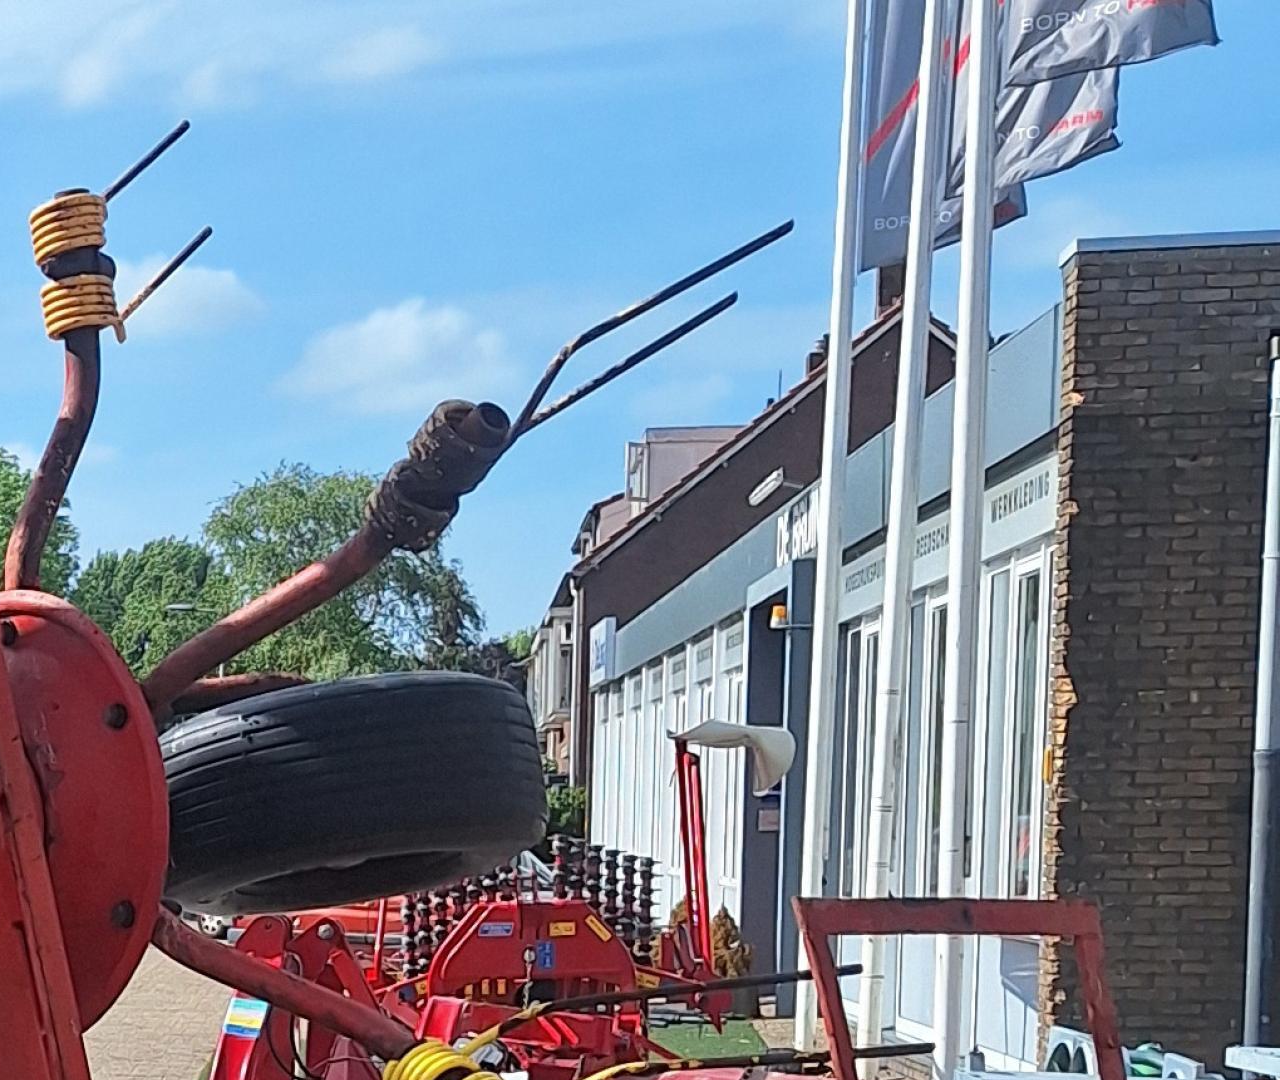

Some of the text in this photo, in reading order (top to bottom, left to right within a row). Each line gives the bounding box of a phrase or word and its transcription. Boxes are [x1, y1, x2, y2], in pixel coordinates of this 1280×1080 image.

[1020, 11, 1086, 34] BORN
[1094, 1, 1120, 17] TO
[991, 470, 1050, 523] WERKKLEDING
